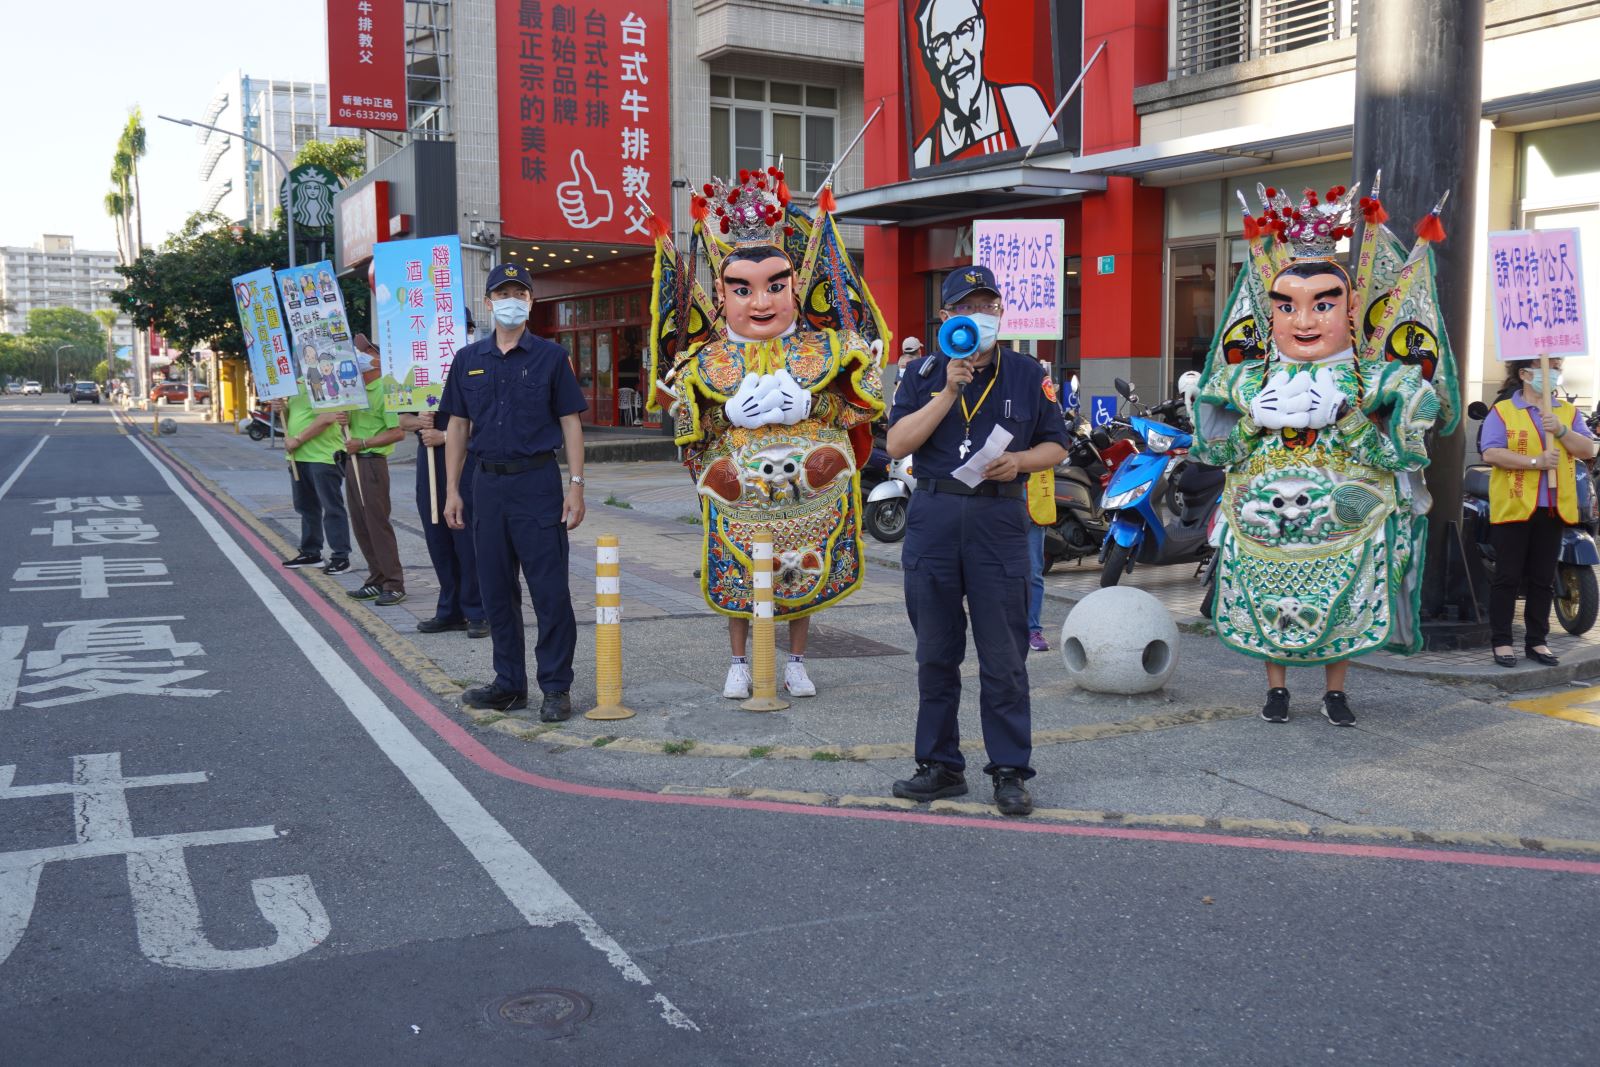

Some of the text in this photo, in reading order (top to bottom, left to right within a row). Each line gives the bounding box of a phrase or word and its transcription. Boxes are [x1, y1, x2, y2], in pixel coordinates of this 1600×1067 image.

[358, 0, 374, 65] 牛排教父
[517, 0, 547, 184] 最正宗的美味
[551, 4, 578, 127] 創始品牌
[584, 8, 610, 128] 台式牛排
[339, 108, 398, 122] 06-6332999
[342, 95, 393, 109] 新營中正店
[620, 12, 650, 236] 台式牛排教父
[979, 232, 1055, 271] 請保持1公尺
[1495, 243, 1574, 288] 請保持1公尺
[406, 260, 430, 387] 酒後不開車
[1501, 285, 1578, 331] 以上社交距離
